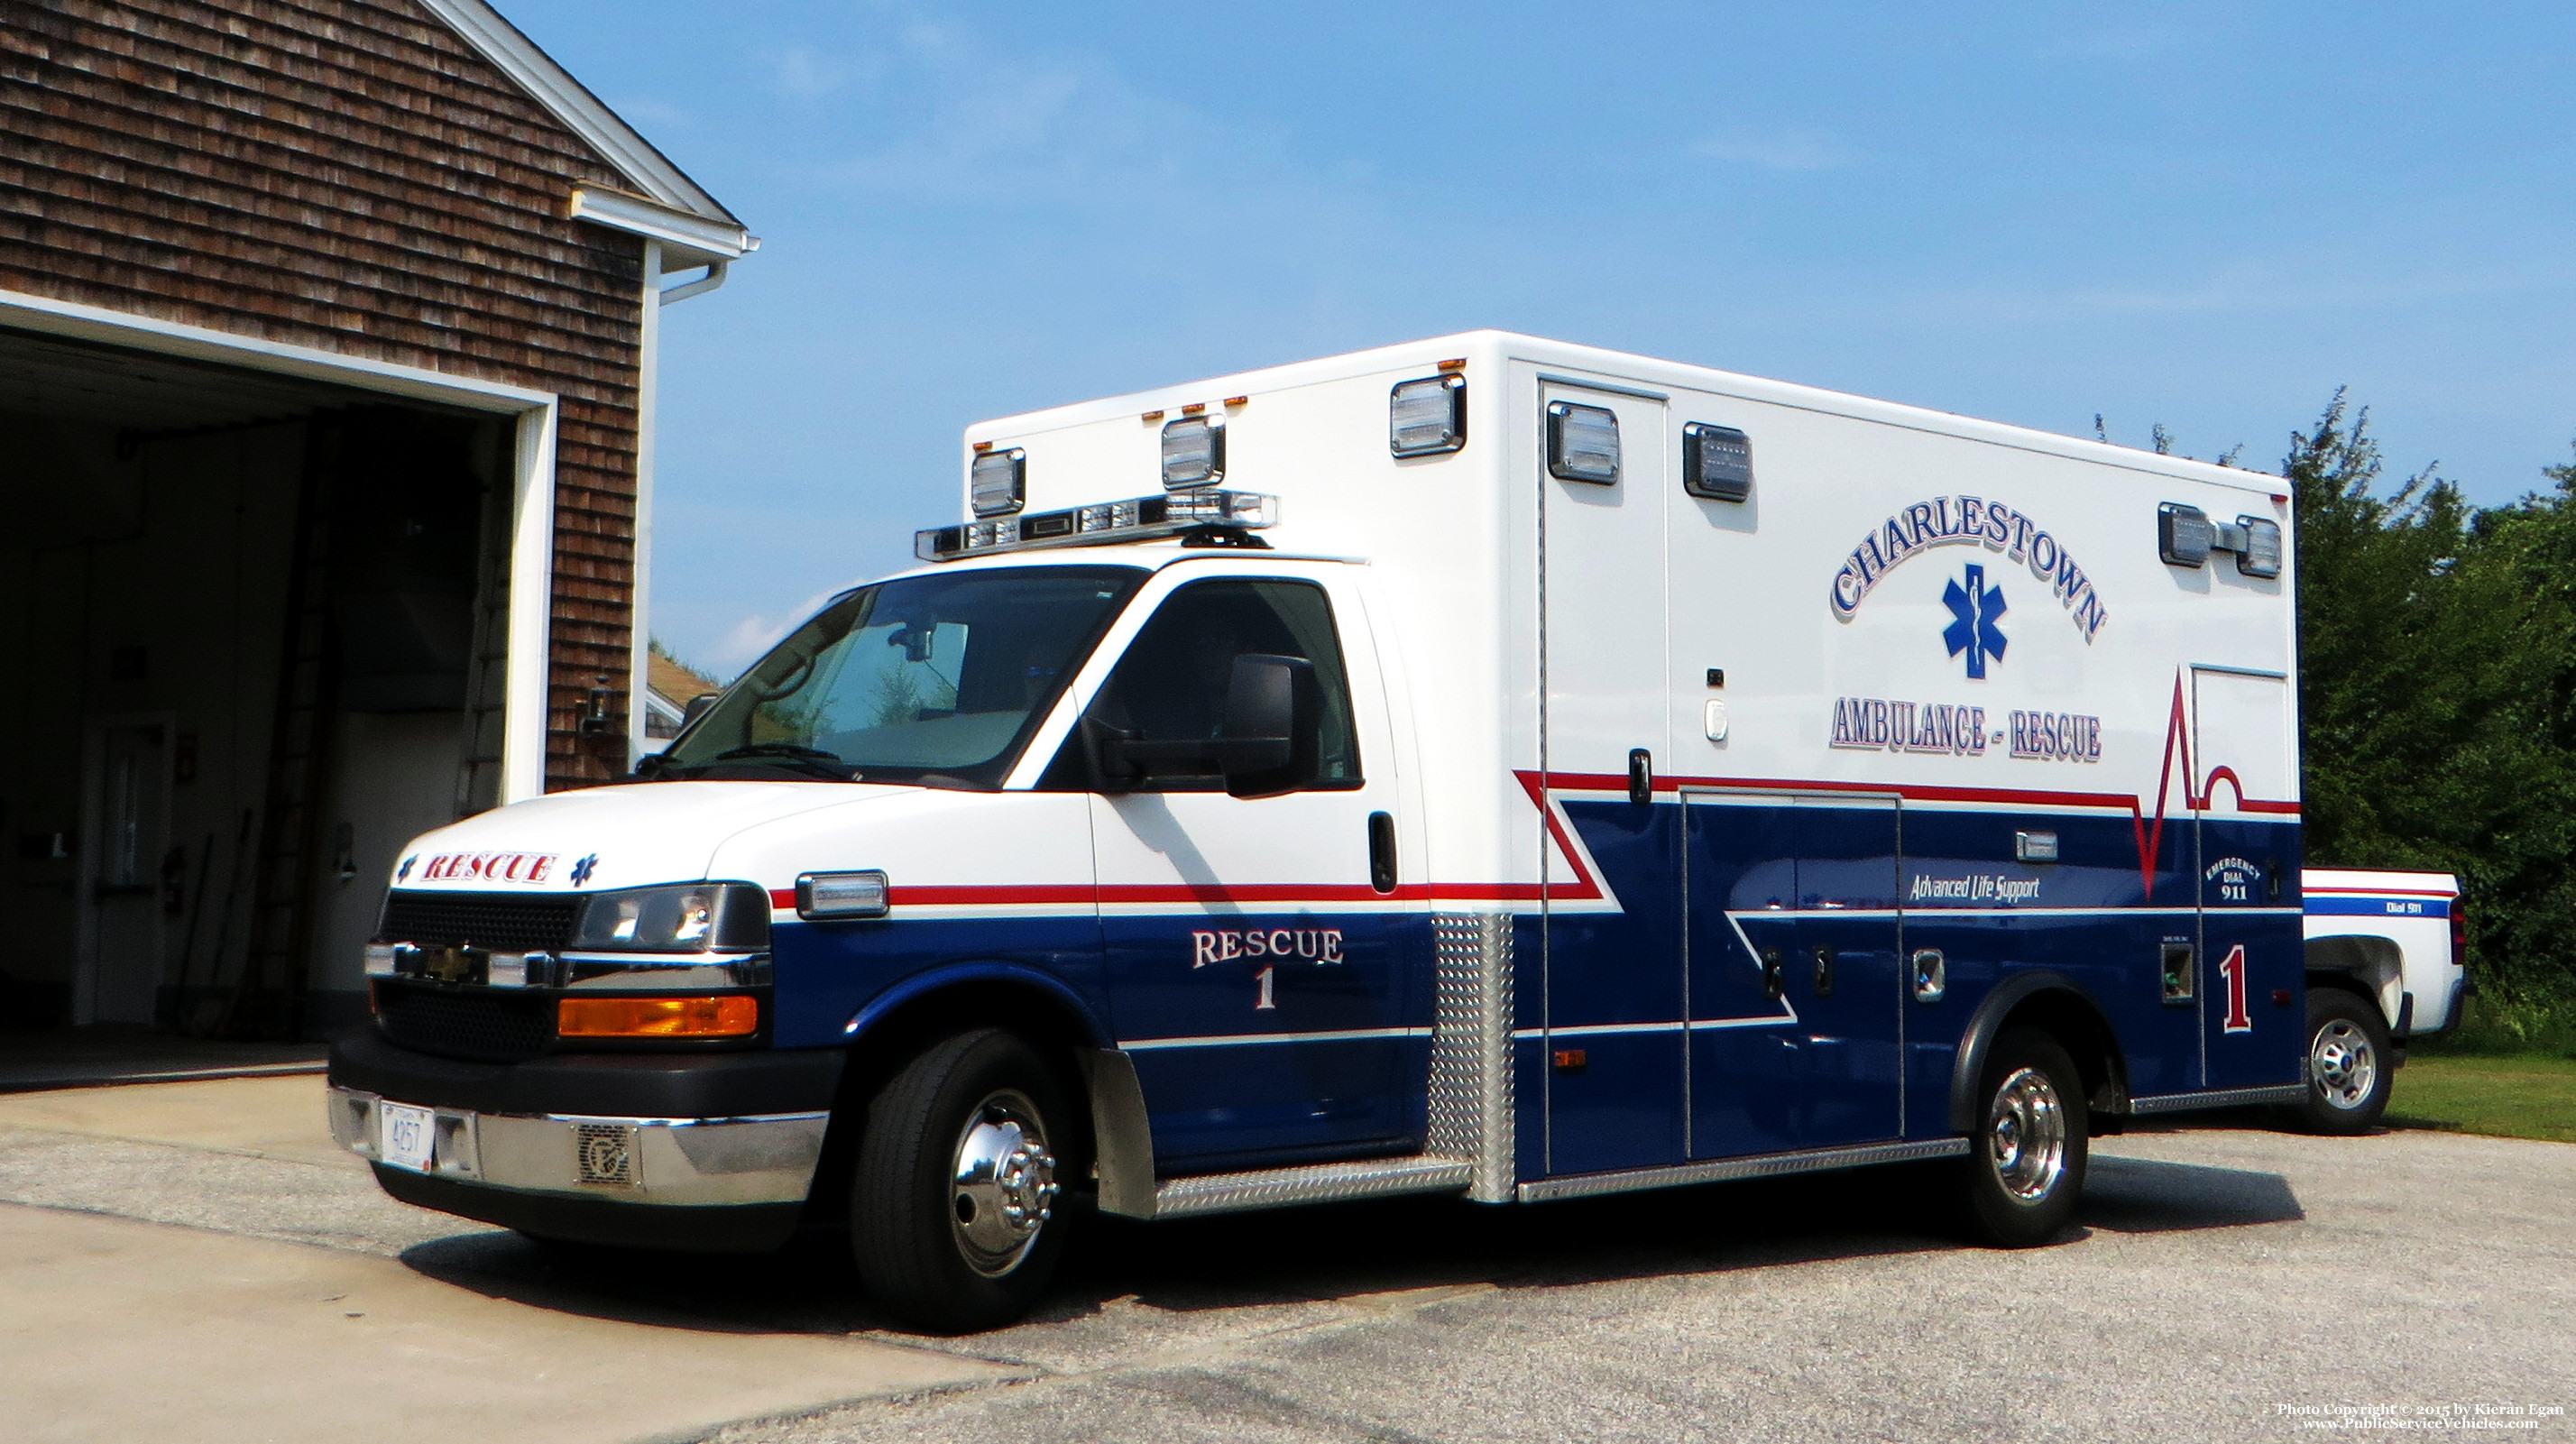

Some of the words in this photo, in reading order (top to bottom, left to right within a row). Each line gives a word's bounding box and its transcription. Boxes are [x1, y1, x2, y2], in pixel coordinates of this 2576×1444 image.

[1830, 495, 2109, 646] CHARLESTOWN
[1829, 696, 1986, 756] AMBULANCE
[2010, 709, 2102, 762] RESCUE
[421, 851, 559, 884] RESCUE
[2205, 858, 2261, 881] EMERGENCY
[2223, 871, 2245, 883] DIAL
[1909, 875, 1971, 900] Advanced
[1972, 875, 1994, 900] Life
[1994, 875, 2040, 903] Support
[2222, 885, 2248, 900] 911
[2386, 902, 2406, 913] Dial
[2407, 903, 2423, 914] 911
[1192, 929, 1344, 970] RESCUE
[1255, 964, 1277, 1010] 1
[2220, 944, 2252, 1035] 1
